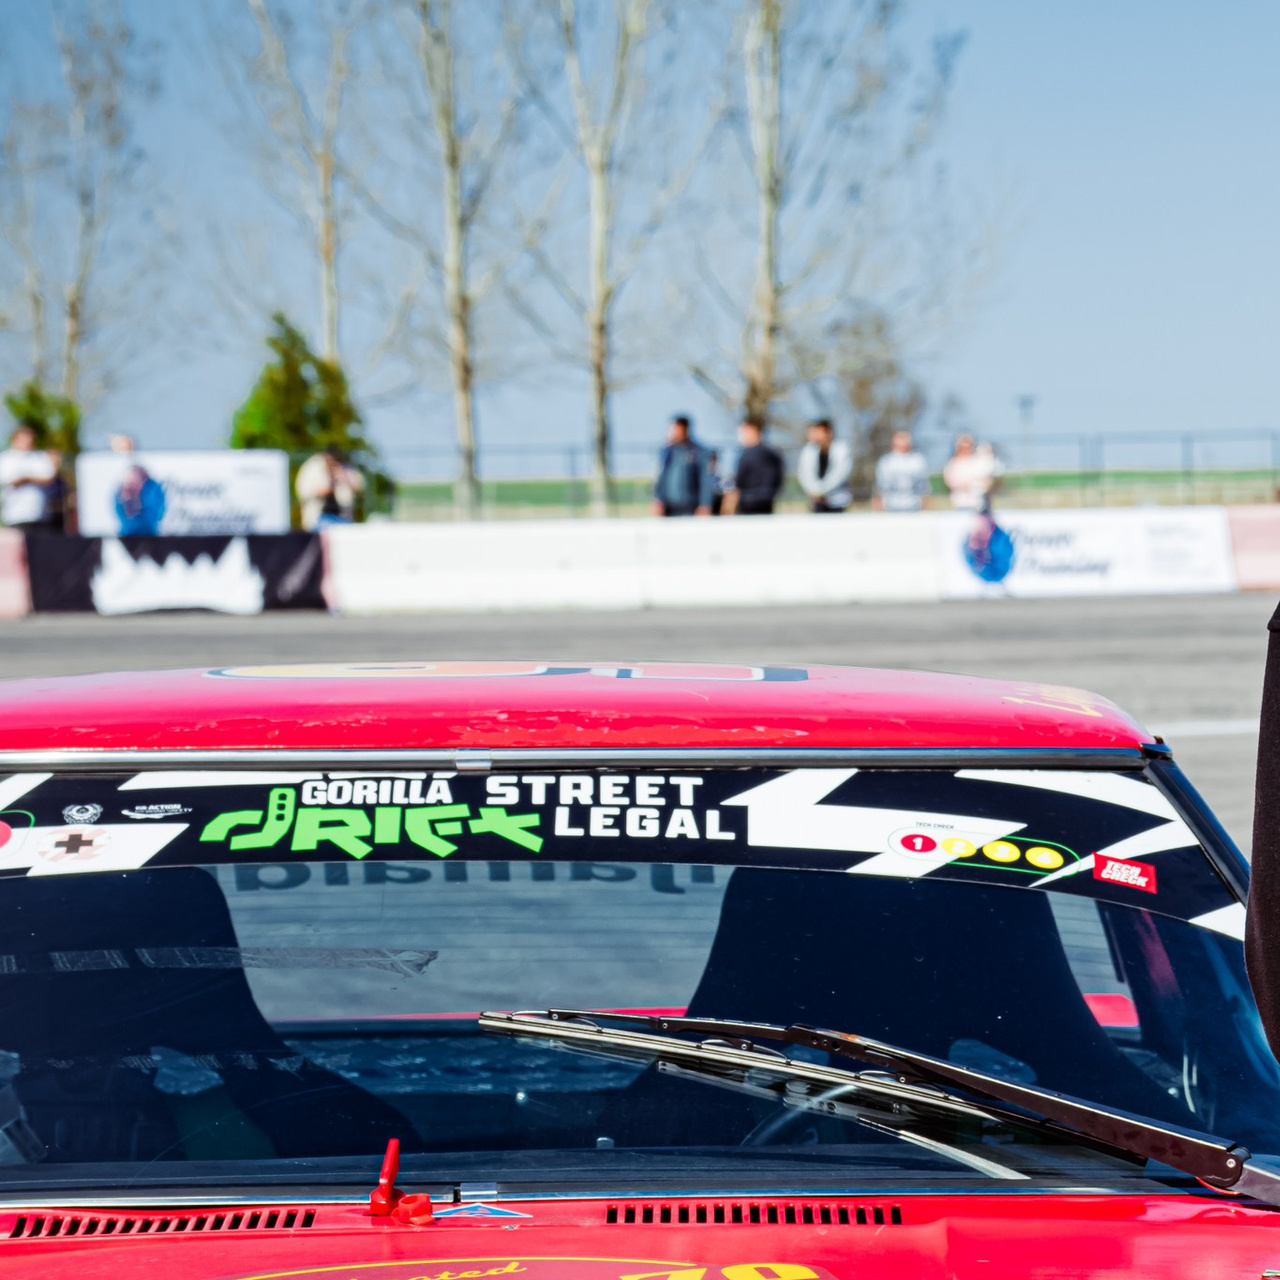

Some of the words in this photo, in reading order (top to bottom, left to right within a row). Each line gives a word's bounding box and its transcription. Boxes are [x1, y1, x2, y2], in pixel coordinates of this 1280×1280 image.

[301, 779, 453, 805] GORILLA
[486, 775, 703, 806] STREET
[554, 806, 736, 840] LEGAL
[913, 837, 923, 850] 1
[951, 840, 965, 853] 2
[994, 844, 1008, 857] 3
[1037, 852, 1051, 864] 4
[1100, 868, 1150, 888] CHECK
[1105, 860, 1142, 878] TECH
